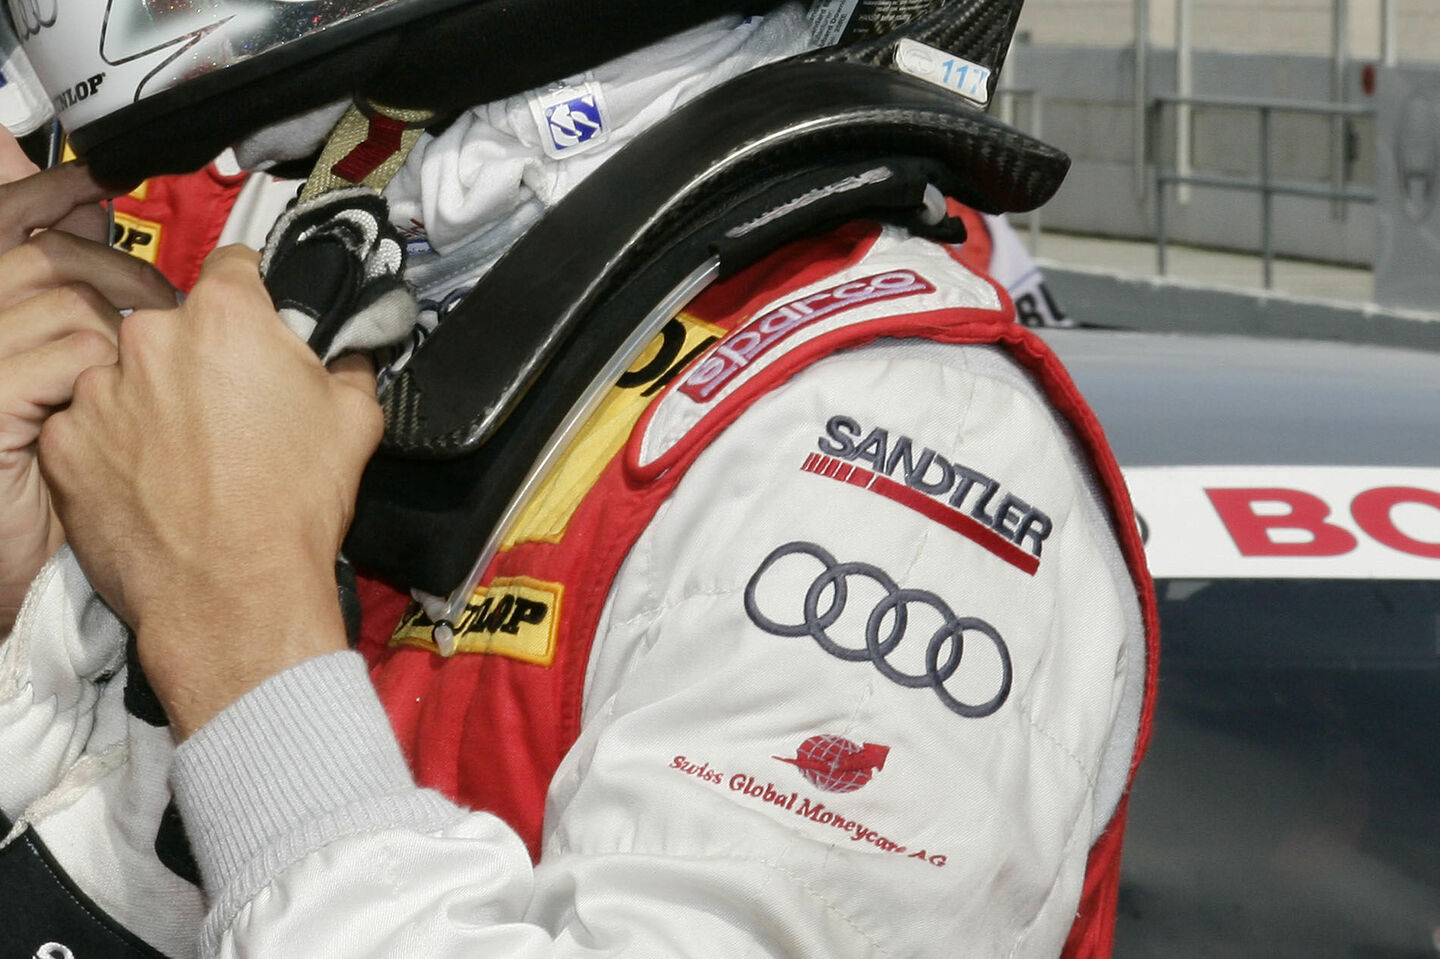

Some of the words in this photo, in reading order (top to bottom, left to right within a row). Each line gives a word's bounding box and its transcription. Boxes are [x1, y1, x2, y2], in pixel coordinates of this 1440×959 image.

[55, 74, 105, 112] NLOP
[685, 270, 918, 390] sparco
[816, 414, 1054, 559] SANDTLER
[668, 755, 724, 786] Swiss
[728, 772, 796, 811] Global
[795, 798, 907, 855] Moneycare
[907, 848, 949, 868] AG
